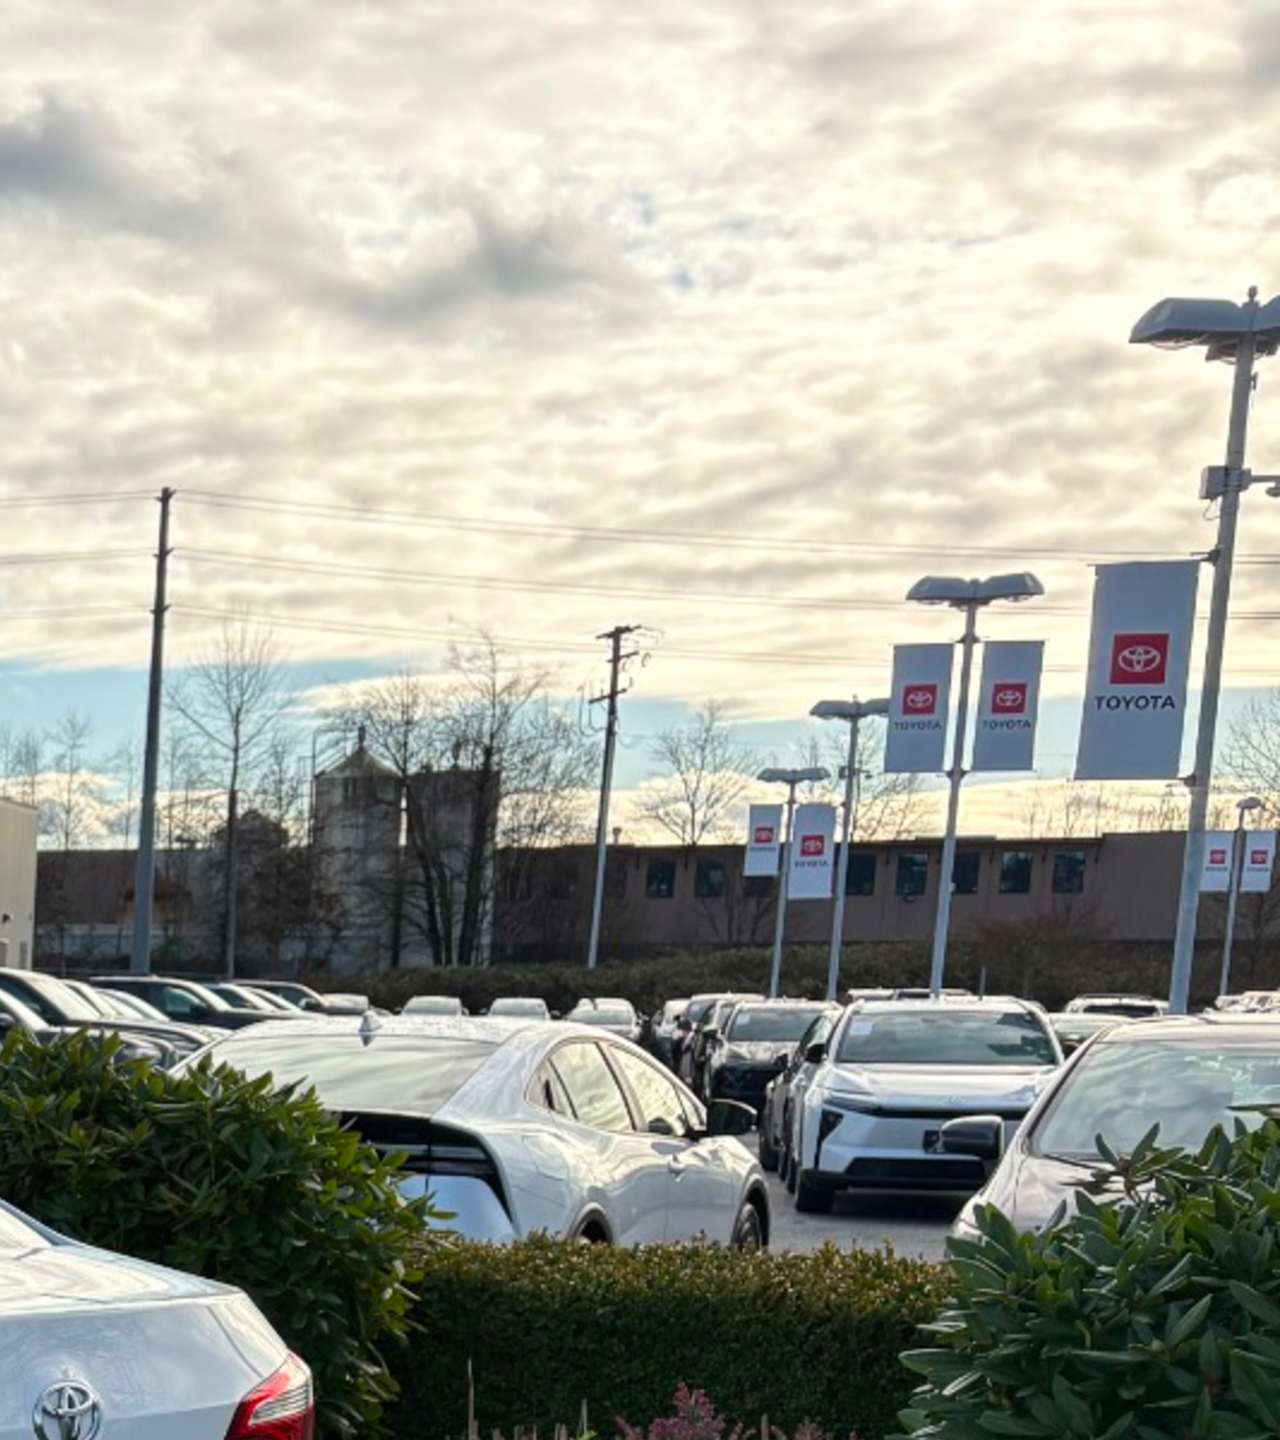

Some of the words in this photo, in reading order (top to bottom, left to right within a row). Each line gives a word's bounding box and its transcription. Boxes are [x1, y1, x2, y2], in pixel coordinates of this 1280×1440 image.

[1095, 695, 1176, 711] TOYOTA
[894, 720, 942, 731] TOYOTA
[983, 719, 1032, 730] TOYOTA
